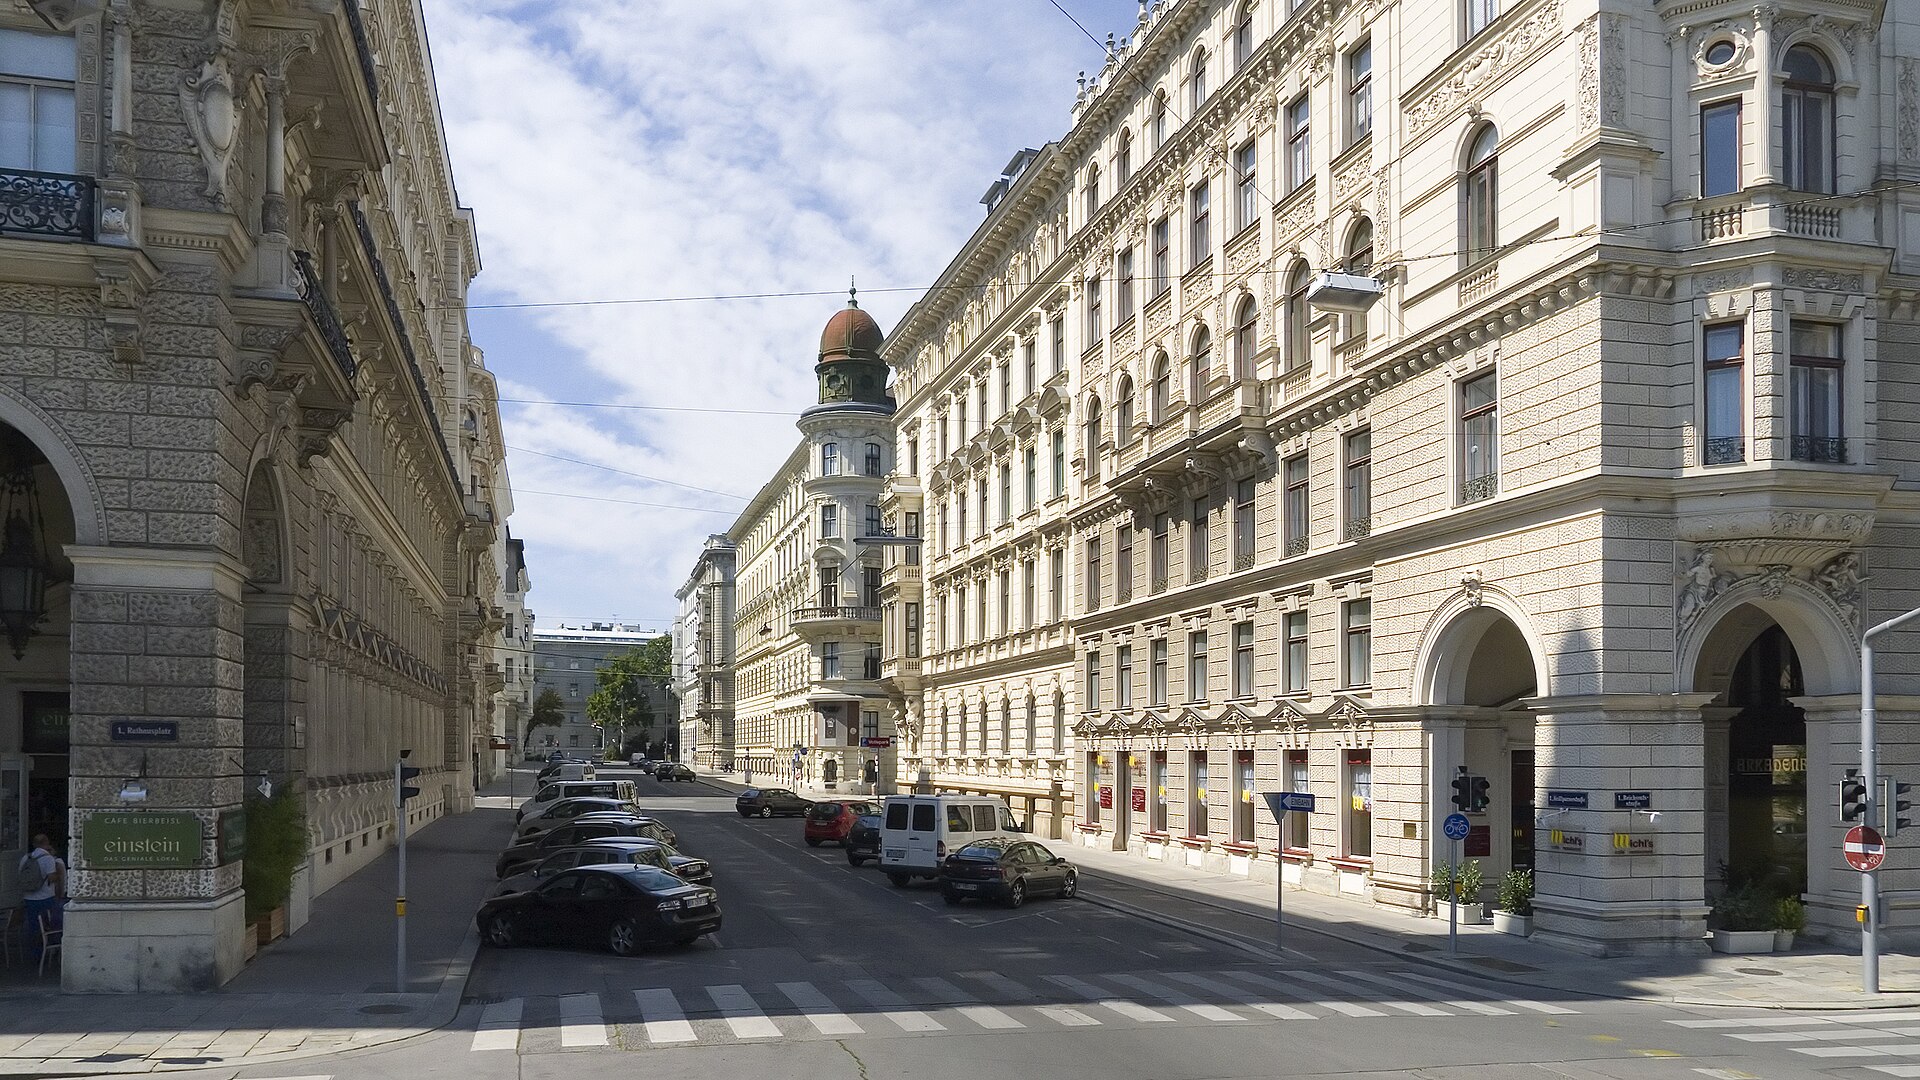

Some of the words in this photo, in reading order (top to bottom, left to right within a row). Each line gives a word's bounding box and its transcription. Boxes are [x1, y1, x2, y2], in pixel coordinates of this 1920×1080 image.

[127, 726, 172, 736] Rathausplatz
[1291, 798, 1311, 806] EINBAHN
[132, 817, 181, 825] BIERBEISL
[104, 836, 180, 853] einstein
